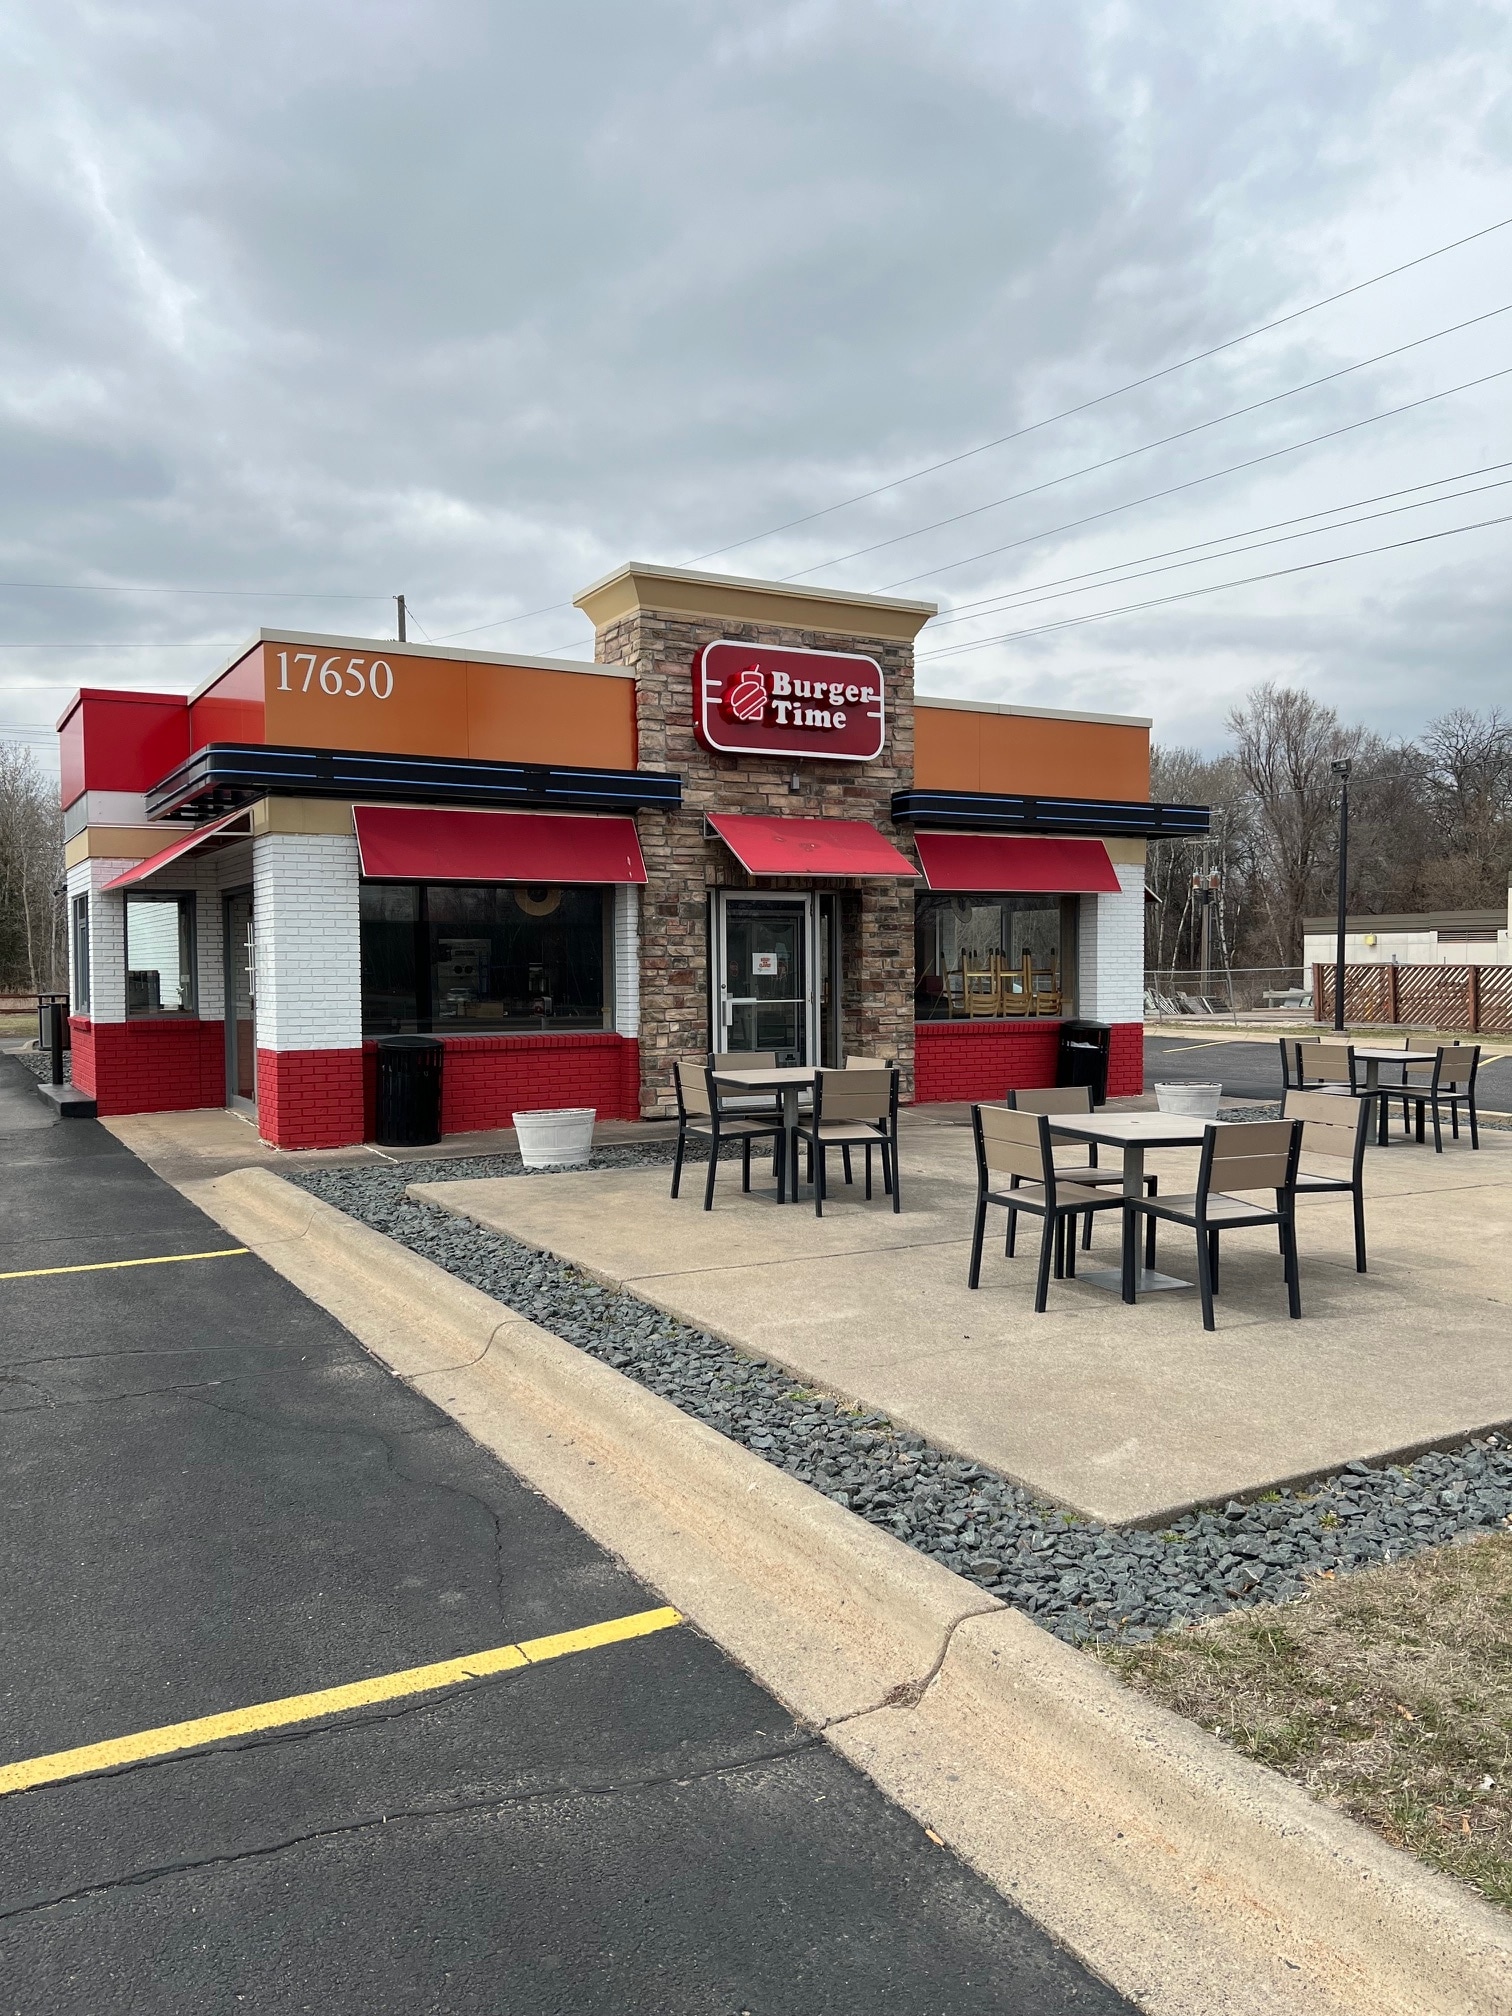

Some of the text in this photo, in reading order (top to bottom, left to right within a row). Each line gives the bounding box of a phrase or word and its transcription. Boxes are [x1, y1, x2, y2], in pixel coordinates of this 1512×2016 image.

[276, 651, 394, 700] 17650
[771, 671, 874, 706] Burger
[771, 700, 847, 729] Time
